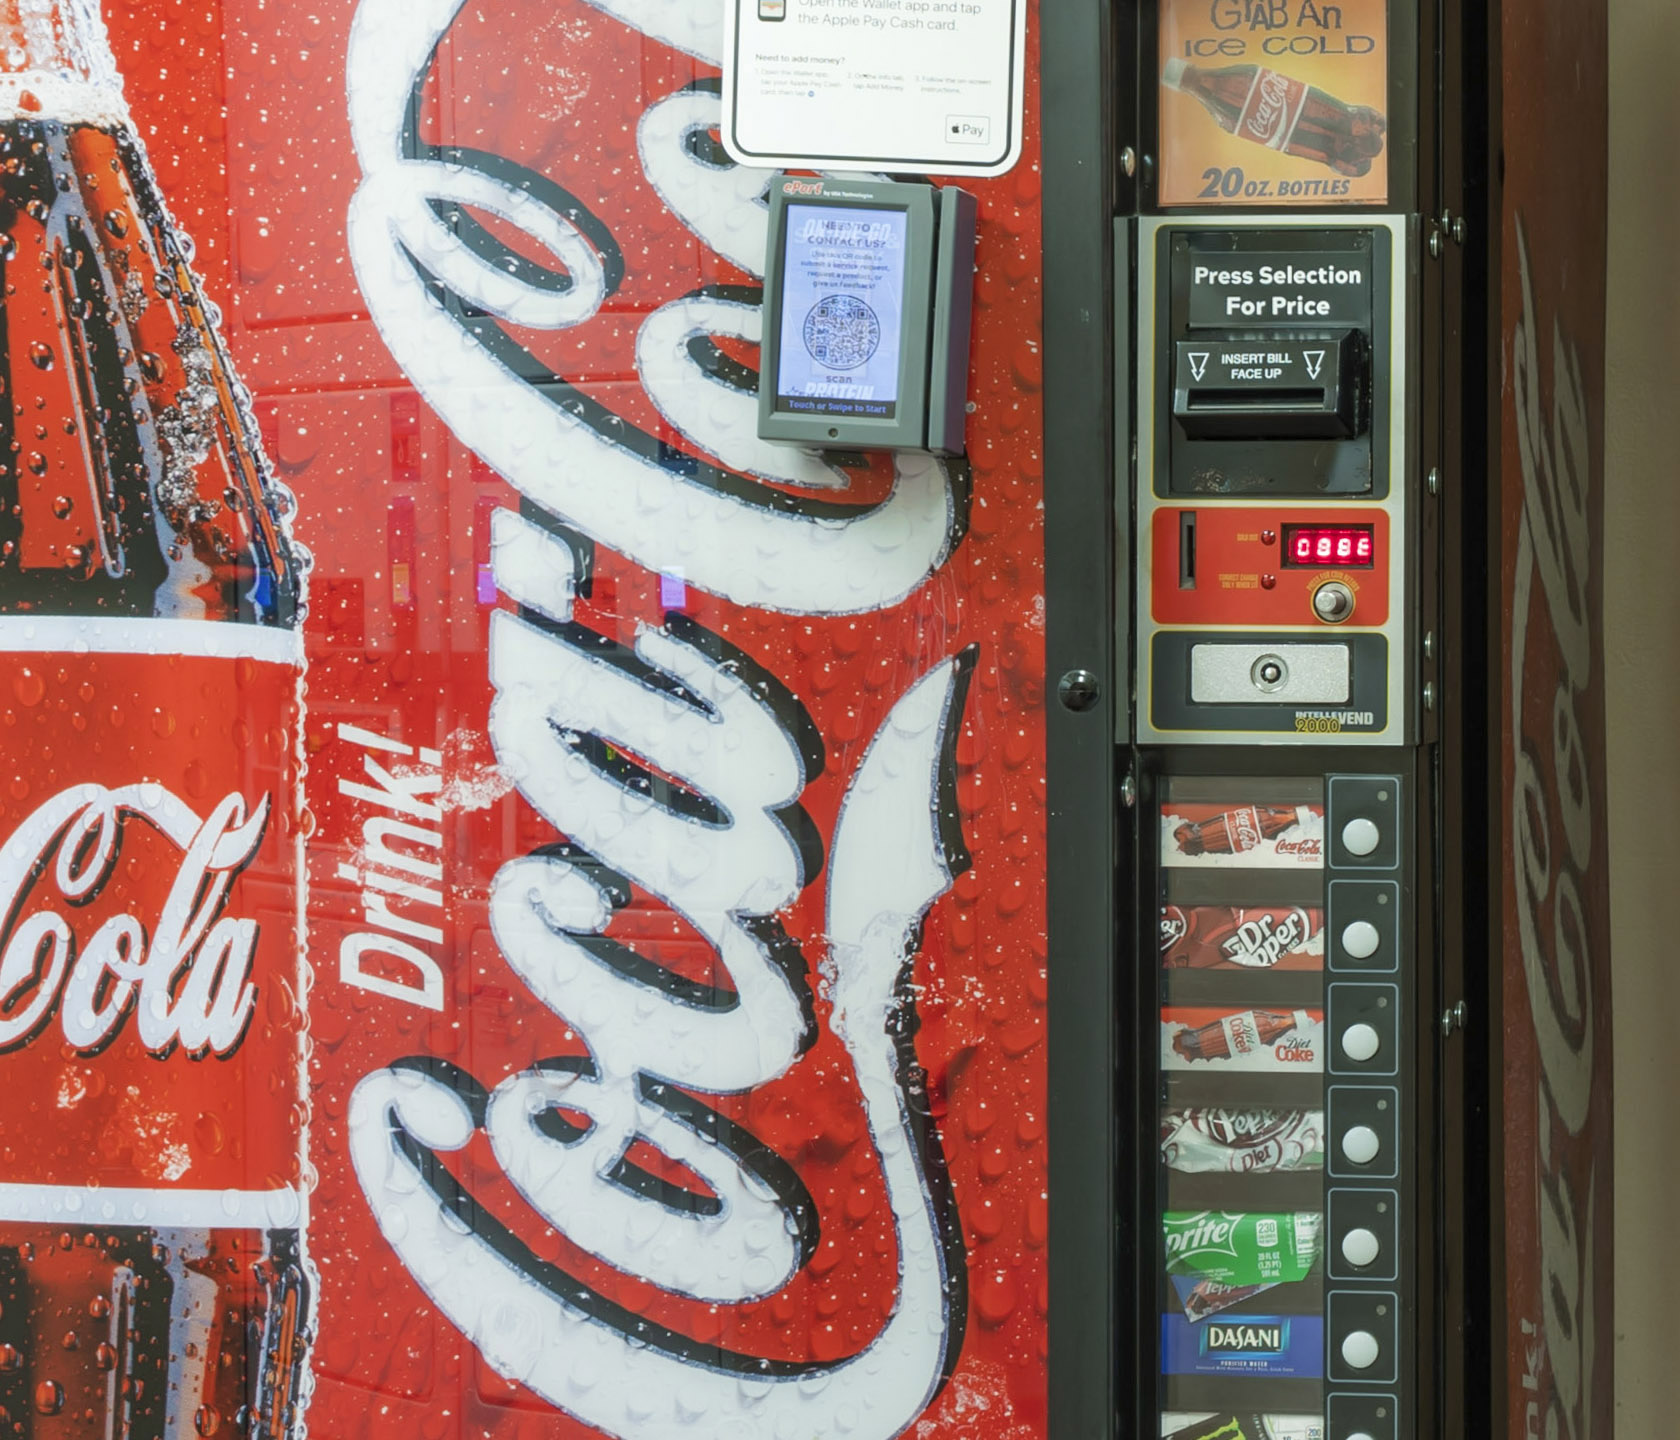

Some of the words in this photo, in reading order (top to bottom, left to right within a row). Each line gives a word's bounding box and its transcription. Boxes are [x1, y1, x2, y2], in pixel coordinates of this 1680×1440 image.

[1262, 36, 1375, 55] COLD
[1198, 167, 1244, 198] 20
[1245, 181, 1272, 197] OZ.
[1278, 179, 1350, 196] BOTTLES
[1194, 266, 1252, 284] Press
[1259, 266, 1361, 284] Selection
[1226, 297, 1266, 315] For
[1272, 296, 1330, 315] Price
[1221, 354, 1265, 364] INSERT
[1267, 353, 1292, 364] BILL
[1231, 369, 1262, 379] FACE
[1264, 369, 1282, 379] UP
[1275, 839, 1322, 855] Coca-Cola
[339, 722, 444, 1011] Drink!
[1275, 1045, 1314, 1062] Coke
[1209, 1326, 1280, 1349] DASANI
